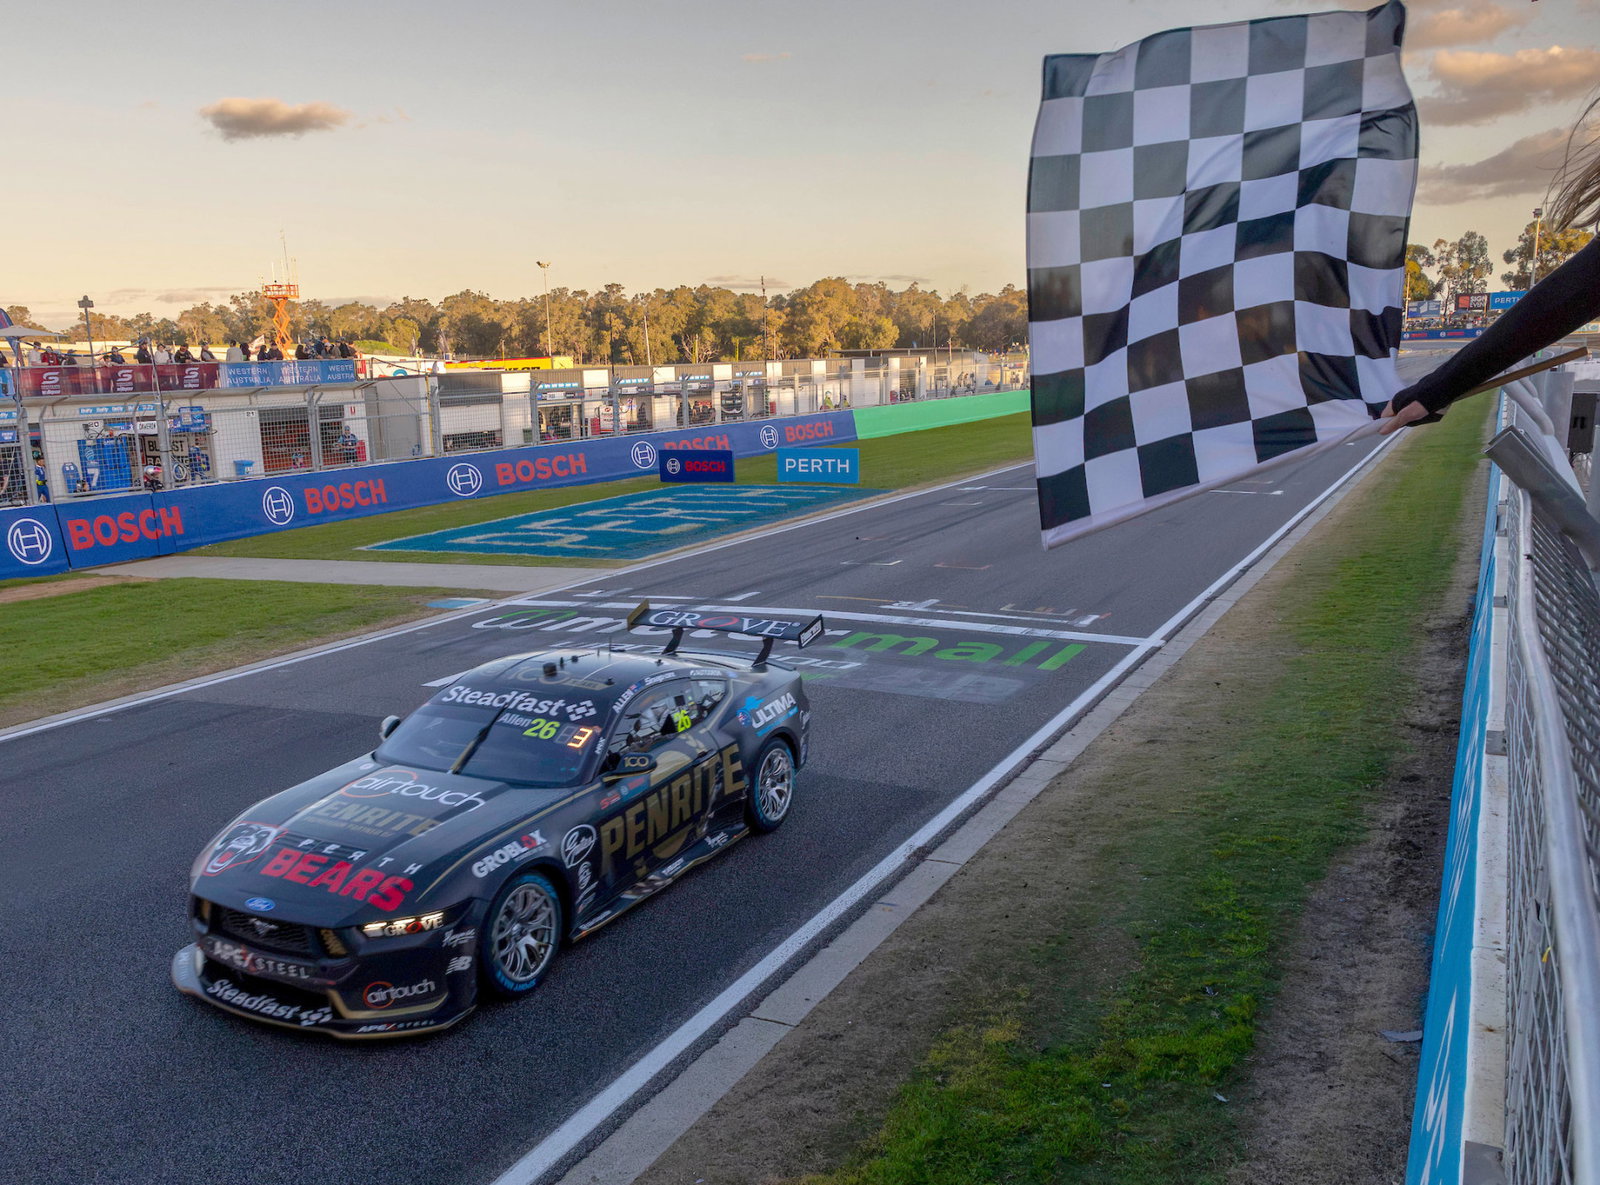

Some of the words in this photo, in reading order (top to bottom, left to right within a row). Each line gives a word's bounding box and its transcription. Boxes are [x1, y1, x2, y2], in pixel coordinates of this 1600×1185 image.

[227, 376, 271, 385] AUSTRALIA
[148, 440, 184, 452] BLST
[785, 421, 834, 442] BOSCH
[496, 453, 587, 486] BOSCH
[685, 461, 726, 472] BOSCH
[785, 458, 850, 473] PERTH
[304, 479, 388, 514] BOSCH
[67, 506, 185, 550] BOSCH
[446, 486, 840, 550] PERTH
[649, 611, 793, 637] GROVE
[441, 685, 566, 717] Steadfast
[752, 692, 796, 729] ULTIMA
[499, 712, 533, 728] Allen
[522, 718, 560, 740] 26
[350, 776, 487, 812] airtouch
[601, 743, 746, 868] PENRITE
[312, 800, 442, 837] ENRITE
[260, 847, 414, 912] BEARS
[383, 917, 445, 937] GROVE
[254, 958, 310, 980] STEEL
[206, 978, 300, 1020] Steadfast
[366, 978, 436, 1004] airtouch
